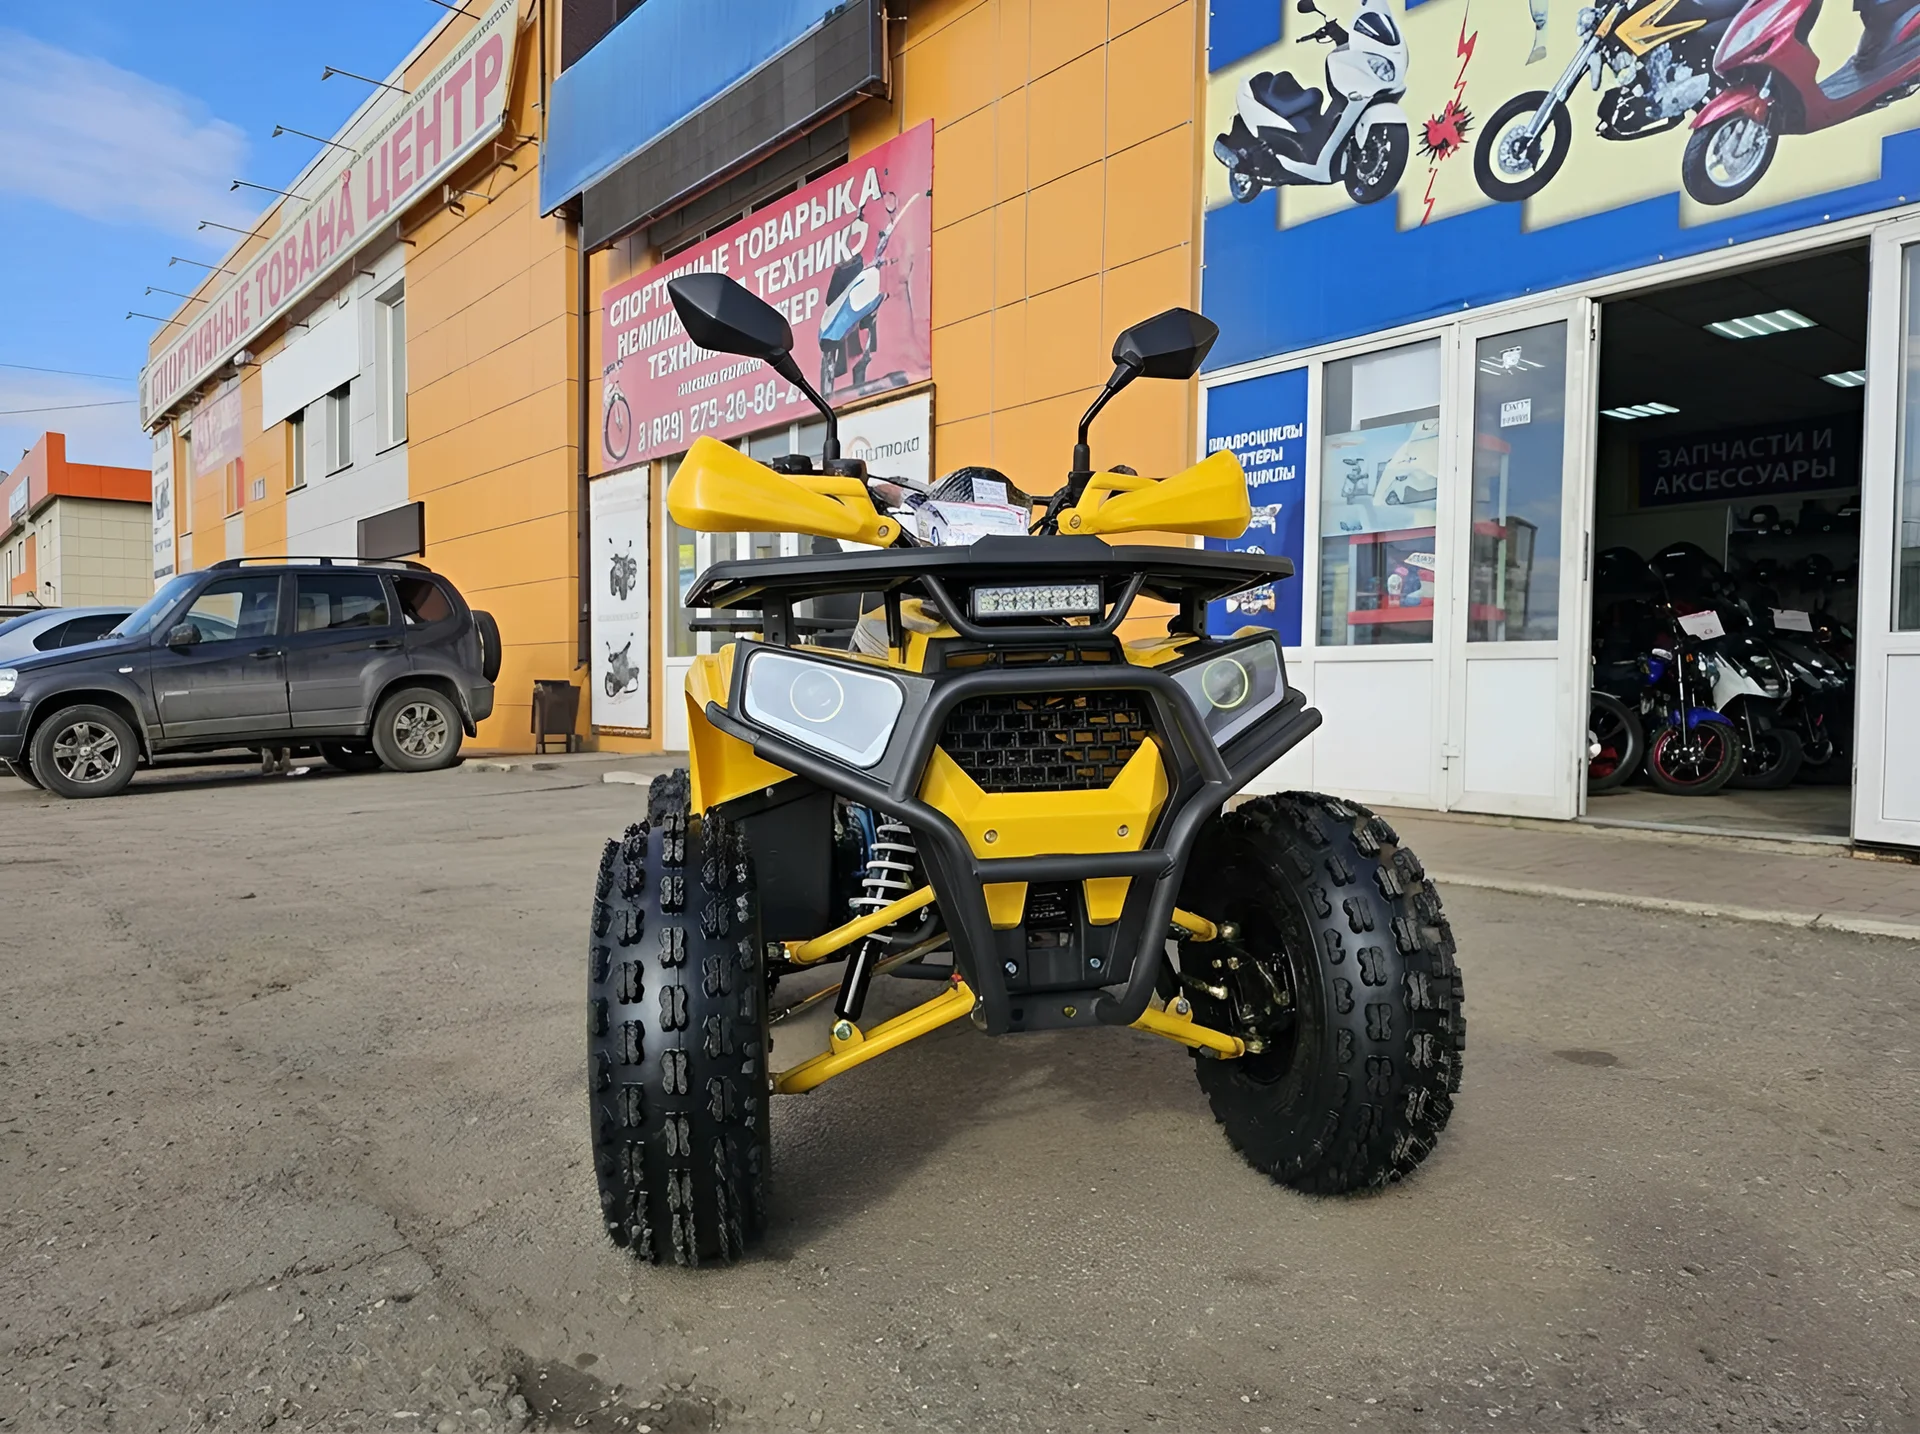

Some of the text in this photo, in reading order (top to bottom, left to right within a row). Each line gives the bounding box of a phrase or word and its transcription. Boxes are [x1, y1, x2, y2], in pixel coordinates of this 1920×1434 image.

[366, 32, 503, 223] ЦЕНТР
[610, 243, 729, 327] СПОРТЫЕ
[1653, 456, 1836, 496] АКСЕССУАРЫ
[1657, 428, 1832, 469] ЗАПЧАСТИ И
